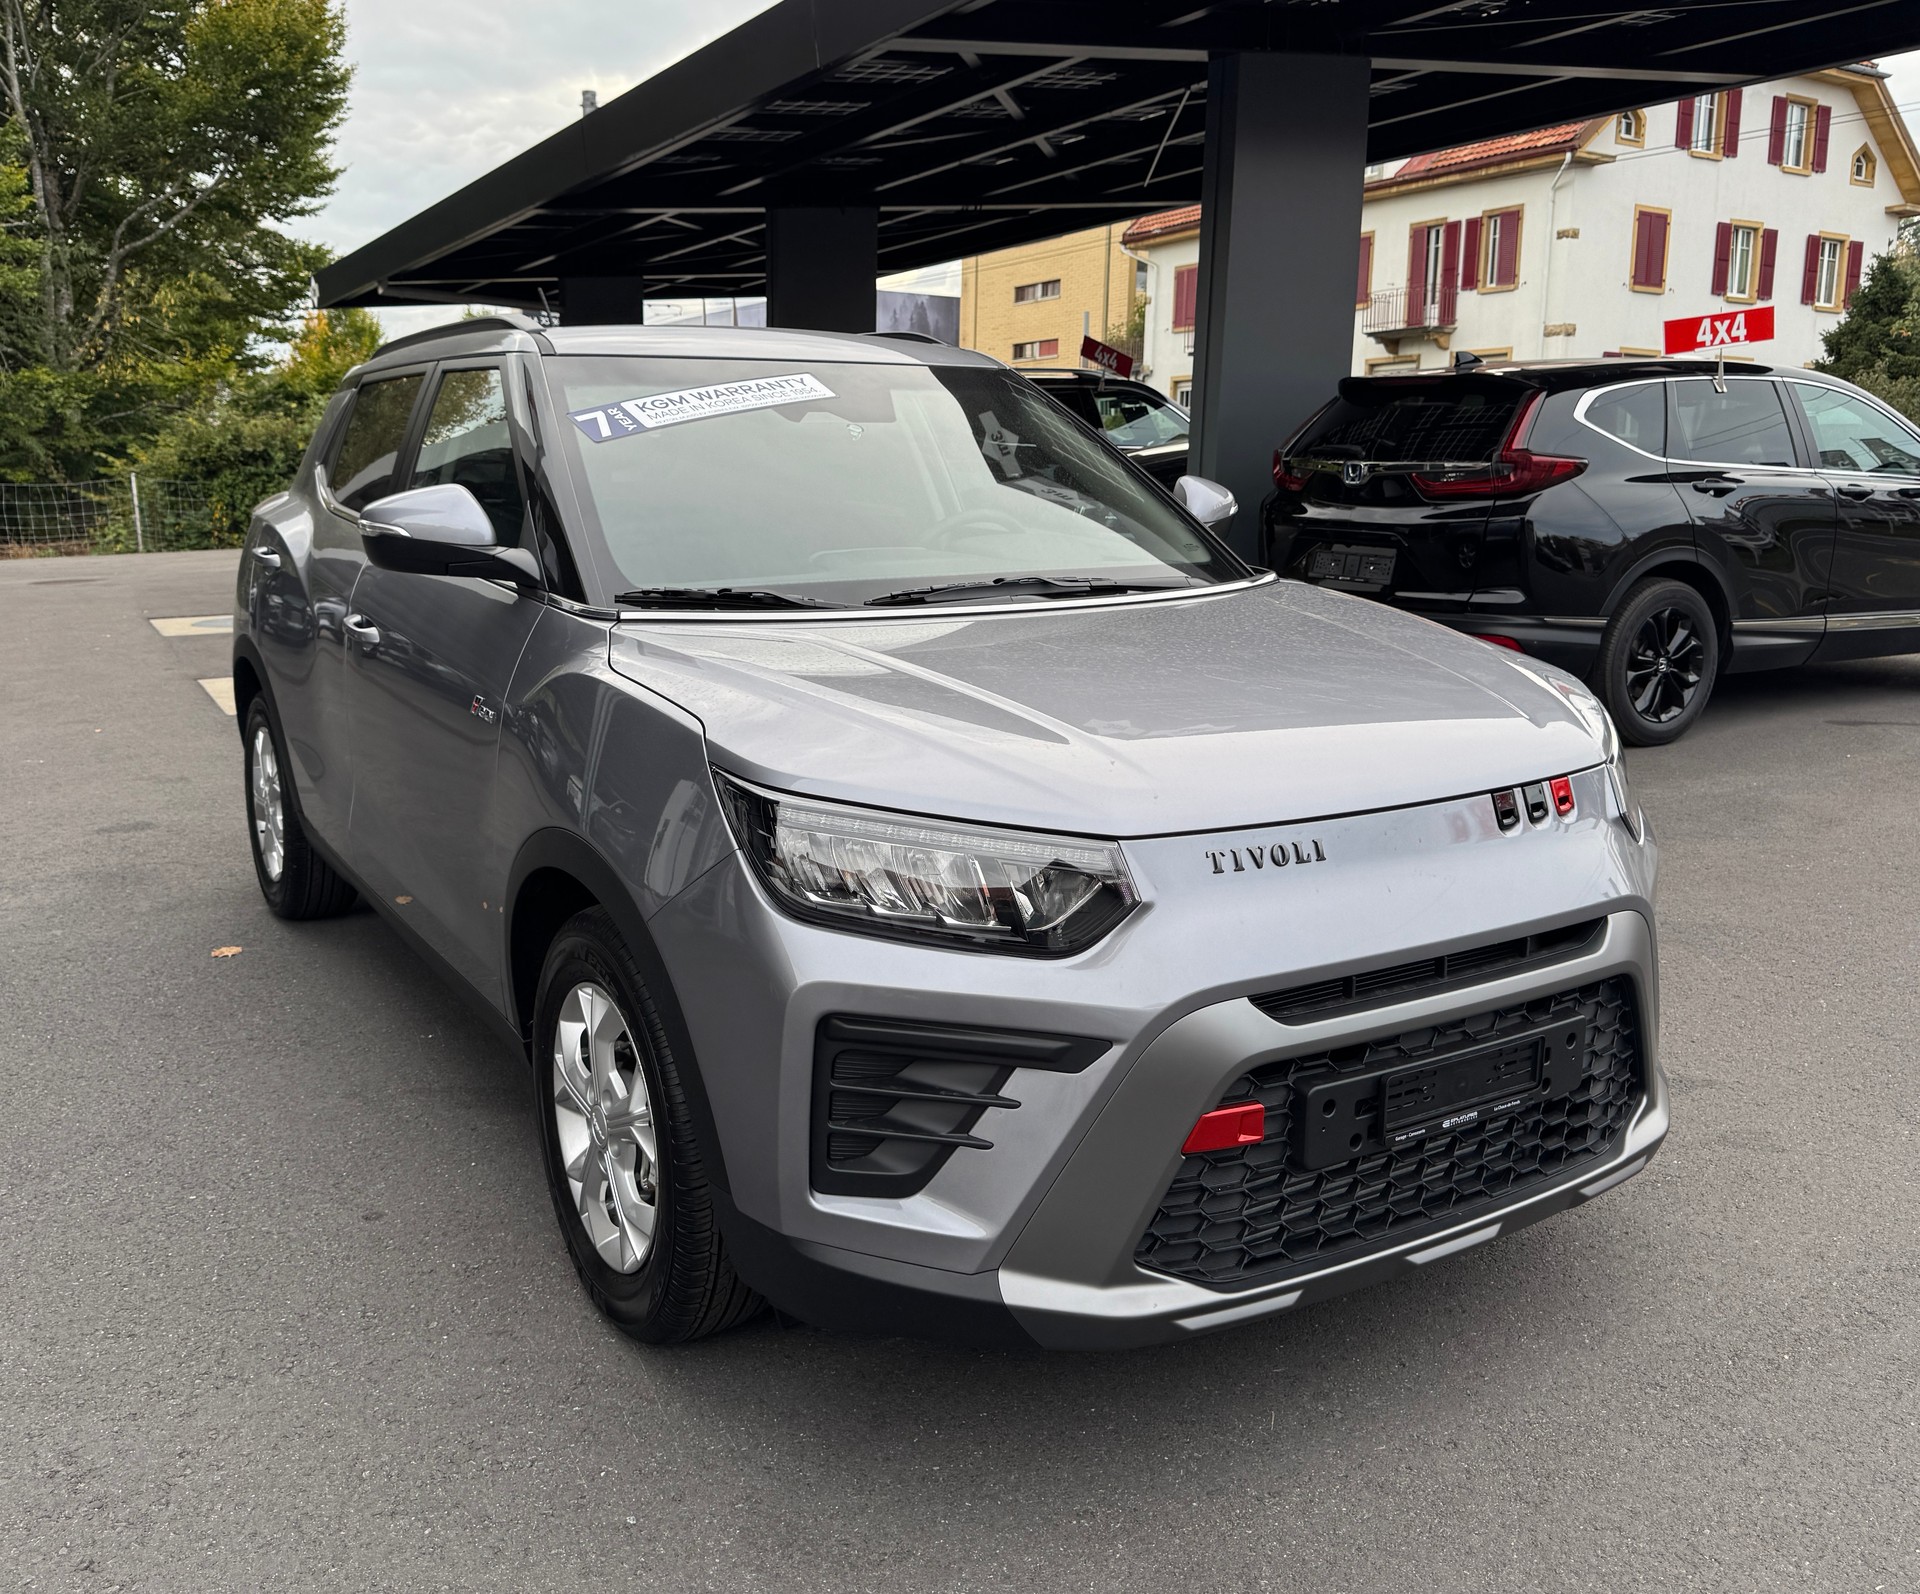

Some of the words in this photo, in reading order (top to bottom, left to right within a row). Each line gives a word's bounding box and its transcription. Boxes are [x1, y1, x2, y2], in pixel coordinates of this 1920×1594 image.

[1696, 312, 1748, 347] 4x4
[1094, 346, 1119, 370] 4x4
[634, 394, 690, 413] KGM
[689, 377, 807, 402] WARRANTY
[647, 406, 690, 421] MADE
[689, 403, 706, 412] IN
[705, 396, 752, 409] KOREA
[751, 390, 791, 402] SINCE
[573, 410, 613, 438] 7
[607, 407, 637, 432] YEAR
[1205, 838, 1327, 874] TIVOLI
